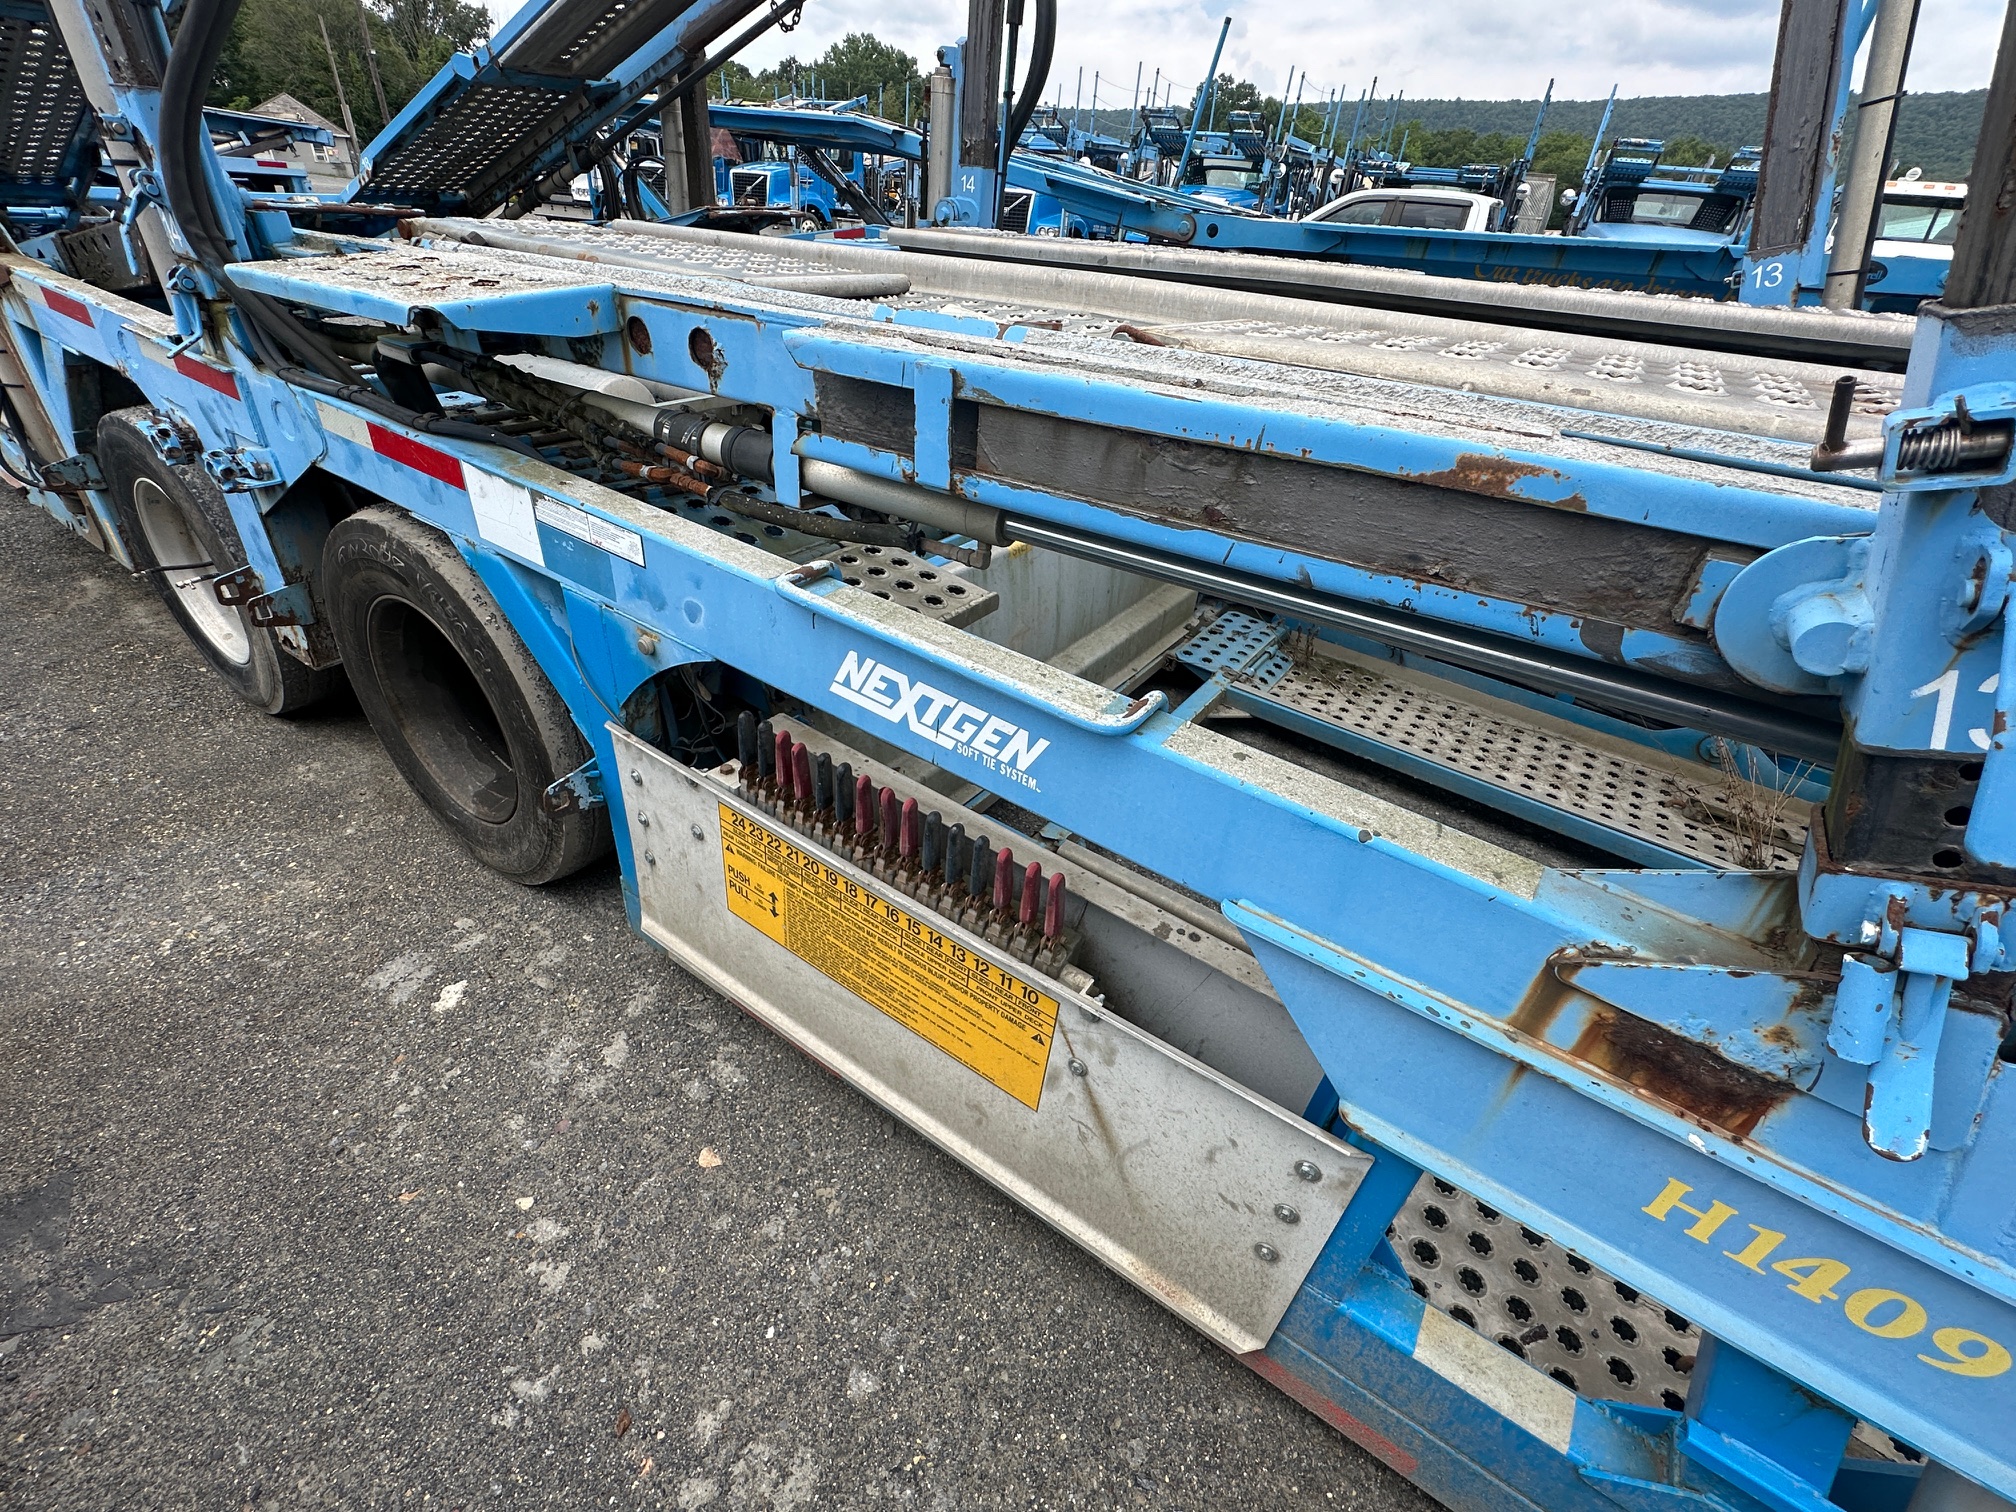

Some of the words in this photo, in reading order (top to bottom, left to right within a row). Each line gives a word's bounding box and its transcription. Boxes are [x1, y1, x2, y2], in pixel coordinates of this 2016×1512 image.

[960, 174, 976, 194] 14
[1751, 262, 1784, 289] 13
[829, 650, 1051, 773] NEXTGEN
[956, 740, 980, 763] SOFT
[981, 753, 997, 772] TIE
[999, 763, 1037, 792] SYSTEM
[735, 838, 750, 850] LOWER
[751, 848, 763, 858] DECK
[727, 864, 750, 886] PUSH
[728, 879, 751, 901] PULL
[731, 812, 746, 831] 24
[748, 822, 763, 841] 23
[766, 833, 781, 853] 22
[785, 845, 799, 863] 21
[802, 855, 819, 875] 20
[823, 868, 838, 886] 19
[842, 880, 857, 898] 18
[863, 893, 878, 909] 17
[884, 905, 899, 923] 16
[905, 917, 921, 935] 15
[927, 930, 943, 949] 14
[950, 944, 966, 962] 13
[973, 958, 989, 977] 12
[998, 973, 1012, 990] 11
[1020, 985, 1039, 1004] 10
[750, 838, 761, 848] LIFT
[767, 849, 781, 860] REAR
[783, 859, 800, 872] FRONT
[804, 871, 818, 883] REAR
[821, 882, 839, 895] FRONT
[842, 895, 858, 908] SLIDE
[862, 907, 878, 920] REAR
[881, 918, 900, 932] FRONT
[904, 932, 921, 945] SLIDE
[926, 945, 943, 958] REAR
[946, 957, 967, 972] FRONT
[971, 972, 990, 986] SLIDE
[994, 986, 1013, 1000] REAR
[1017, 1000, 1041, 1016] FRONT
[843, 905, 859, 917] REAR
[860, 915, 879, 930] UPPER
[880, 927, 897, 941] DECK
[757, 862, 775, 877] FAILURE
[776, 873, 782, 882] TO
[783, 878, 801, 893] COMPLY
[802, 890, 814, 901] WITH
[814, 897, 829, 911] THESE
[830, 907, 865, 933] INSTRUCTIONS
[866, 929, 876, 939] MAY
[877, 936, 896, 952] RESULT
[897, 948, 903, 956] IN
[903, 952, 926, 970] SERIOUS
[927, 966, 947, 982] INJURY
[946, 979, 968, 996] AND/OR
[969, 992, 999, 1014] PROPERTY
[1000, 1011, 1026, 1031] DAMAGE.
[903, 941, 924, 958] MIDDLE
[927, 955, 946, 971] UPPER
[948, 968, 965, 982] DECK
[975, 985, 998, 1001] FRONT
[1000, 999, 1022, 1016] UPPER
[1024, 1014, 1043, 1029] DECK
[1641, 1177, 2013, 1379] H1409
